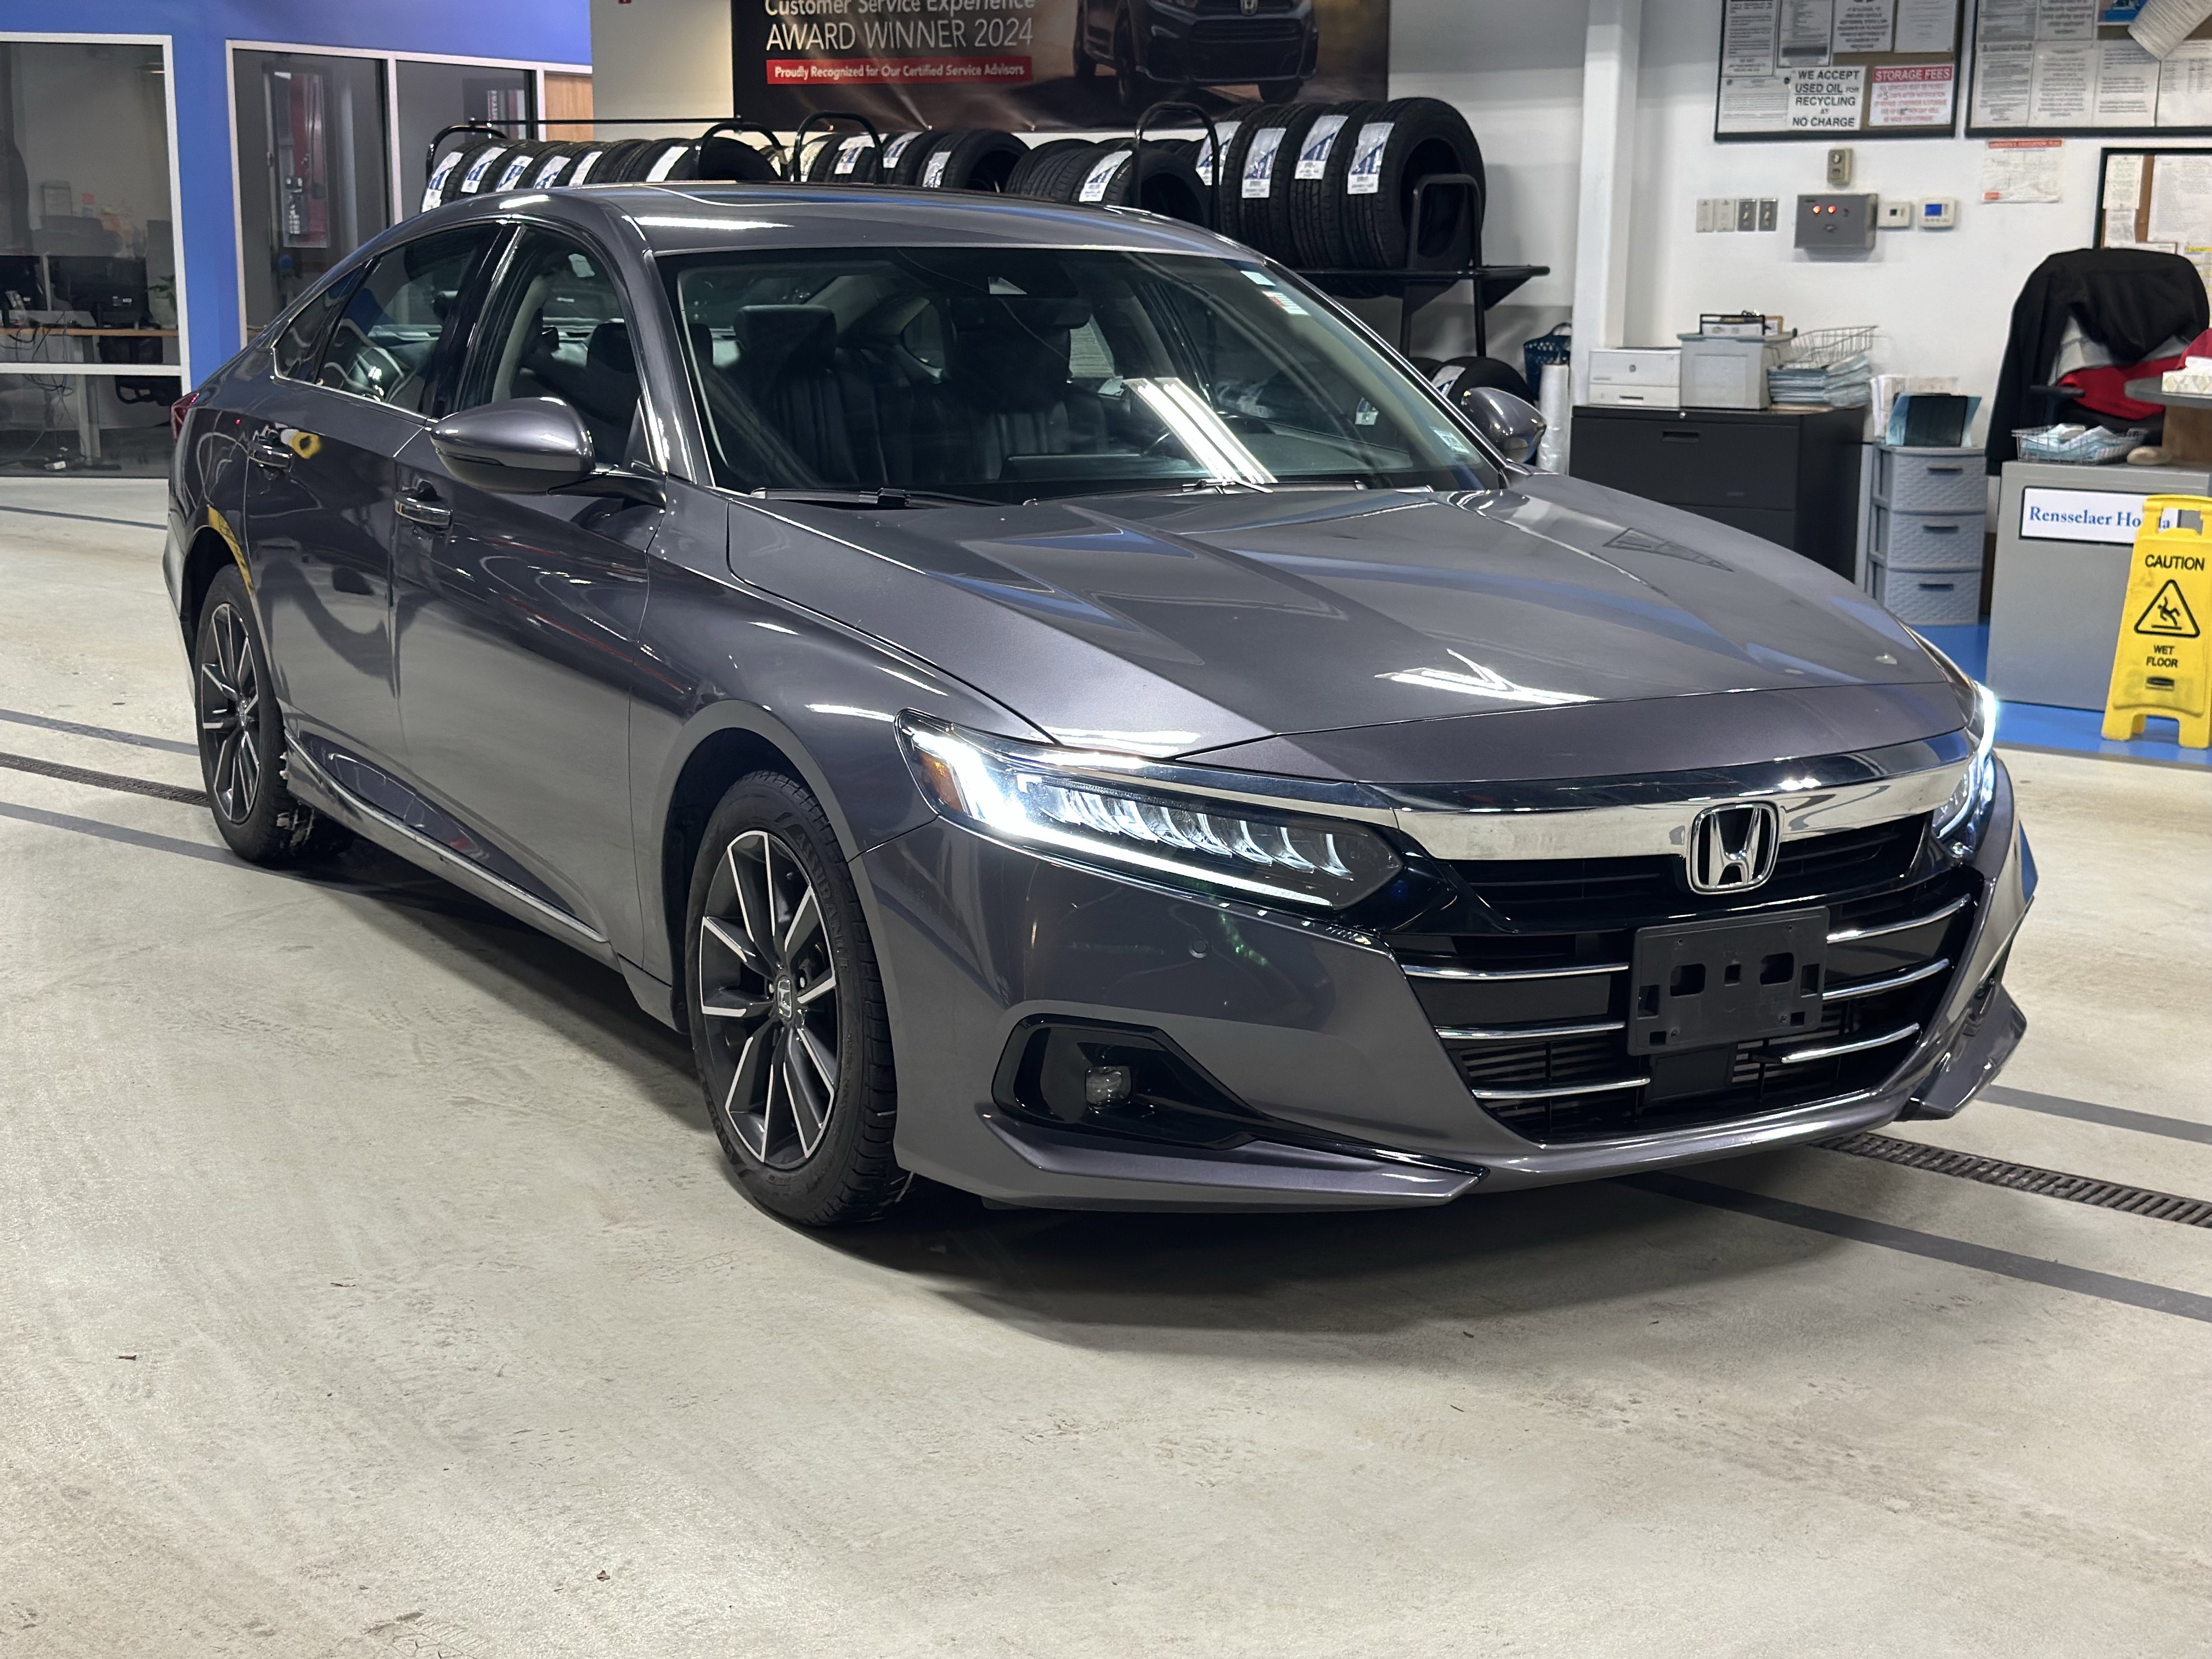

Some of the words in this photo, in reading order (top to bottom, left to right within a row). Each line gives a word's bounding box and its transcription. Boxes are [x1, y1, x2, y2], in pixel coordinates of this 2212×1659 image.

[765, 0, 851, 15] Customer
[857, 0, 921, 13] Service
[766, 22, 855, 50] AWARD
[864, 19, 966, 49] WINNER
[974, 18, 1033, 47] 2024
[775, 65, 809, 81] Proudly
[810, 64, 864, 80] Recognized
[865, 64, 879, 76] for
[881, 64, 900, 77] Our
[903, 63, 944, 76] Certified
[946, 64, 982, 76] Service
[984, 63, 1025, 75] Advisors
[1798, 70, 1814, 80] WE
[1817, 70, 1859, 80] ACCEPT
[1875, 70, 1922, 81] STORAGE
[1925, 67, 1950, 80] FEES
[1795, 83, 1824, 93] USED
[1826, 83, 1843, 93] OIL
[1796, 97, 1855, 106] RECYCLING
[1792, 117, 1808, 126] NO
[1810, 117, 1855, 127] CHARGE
[2029, 506, 2112, 526] Rensselaer
[2145, 554, 2205, 571] CAUTION
[2153, 645, 2175, 655] WET
[2146, 656, 2178, 668] FLOOR
